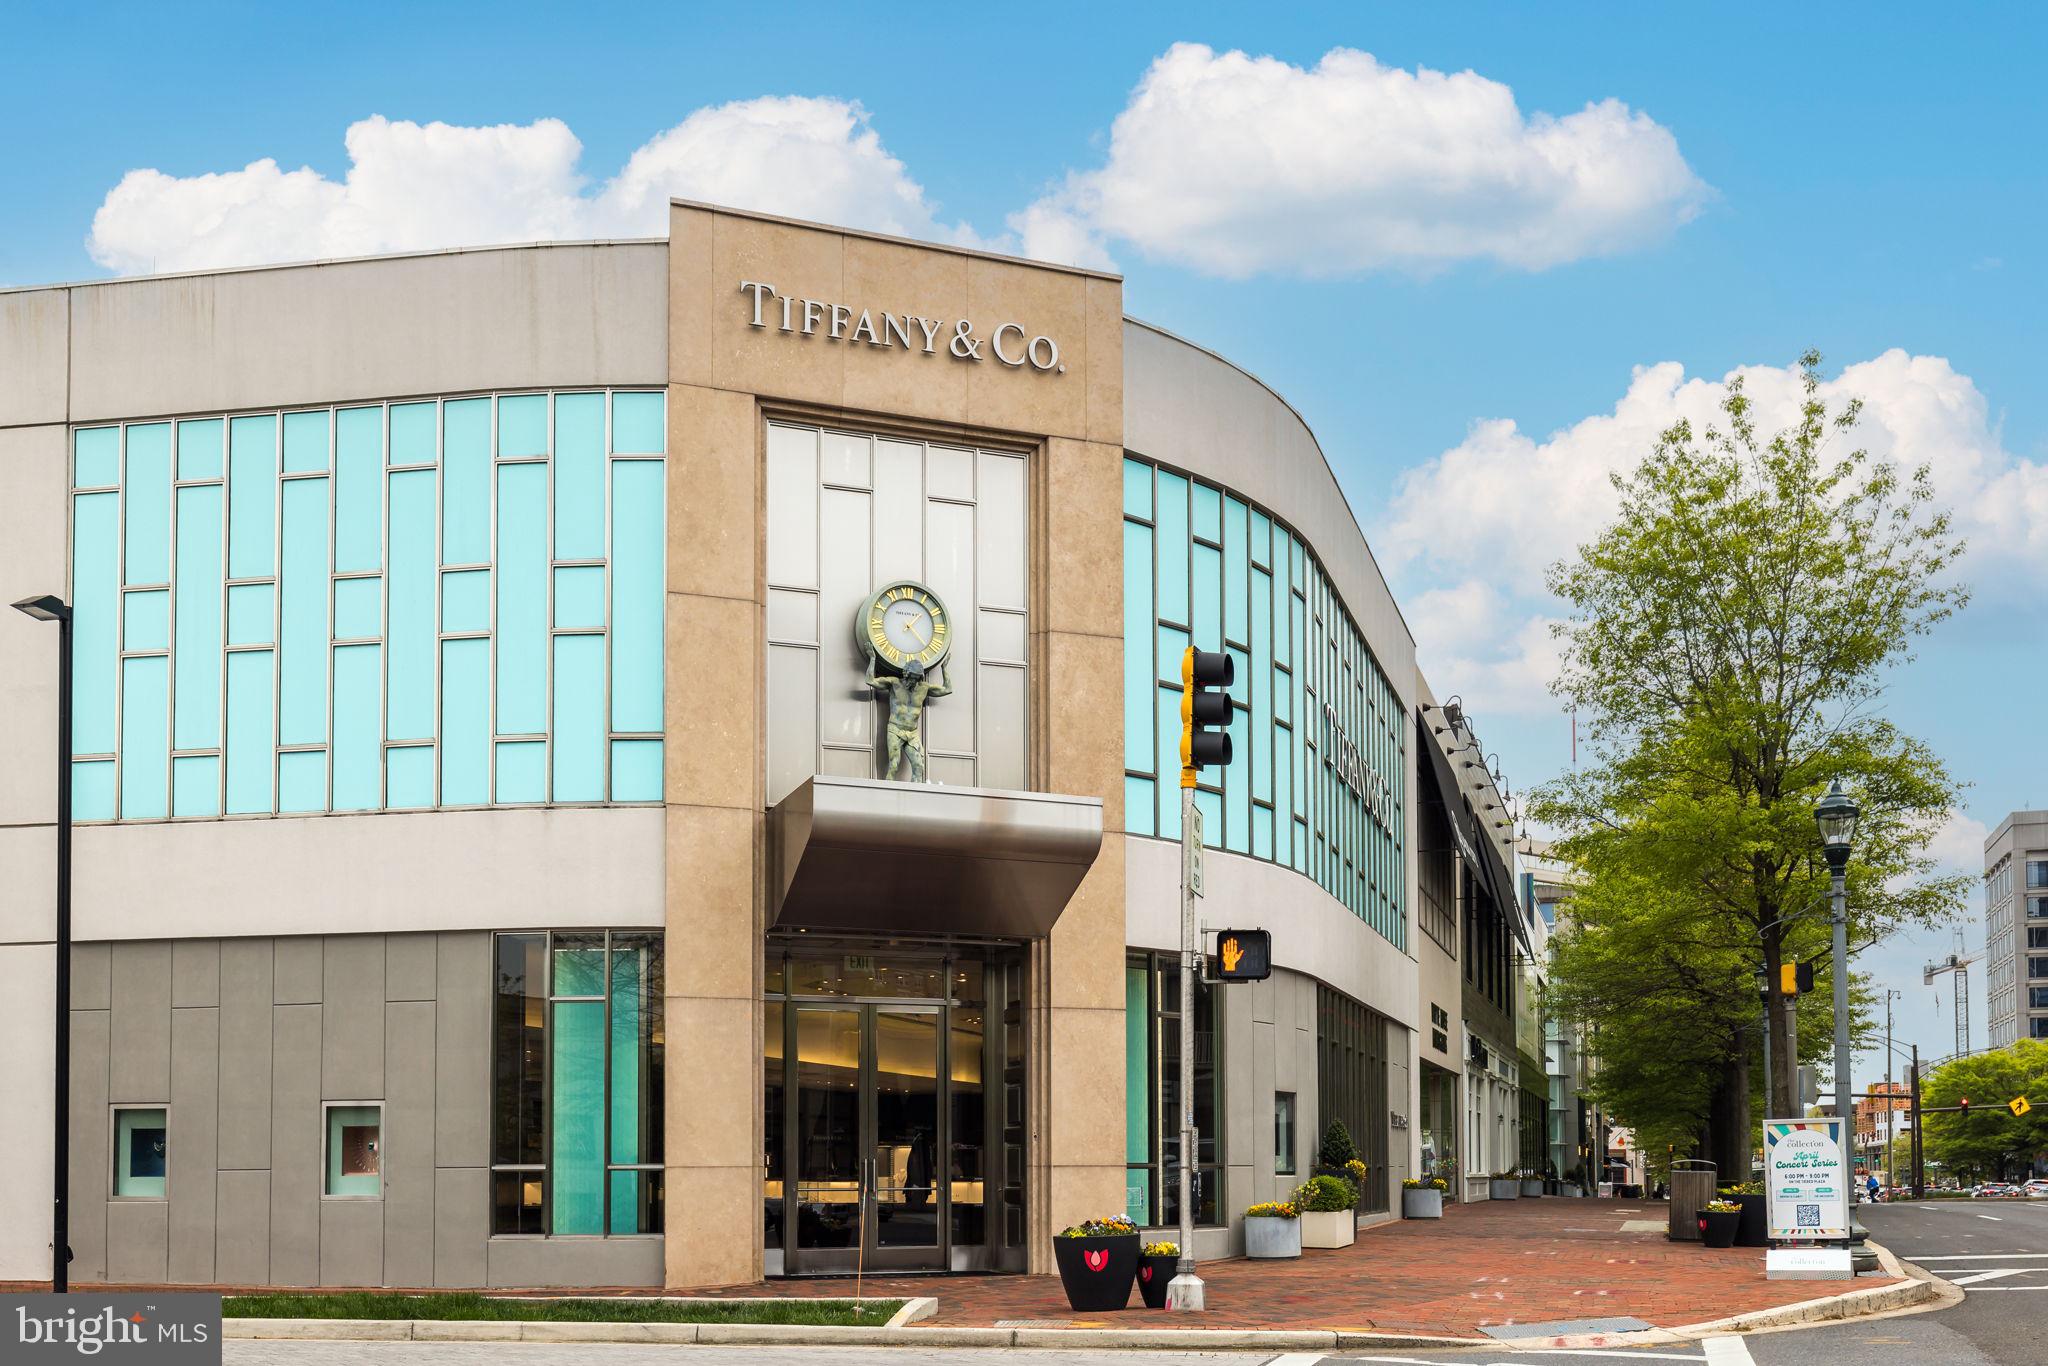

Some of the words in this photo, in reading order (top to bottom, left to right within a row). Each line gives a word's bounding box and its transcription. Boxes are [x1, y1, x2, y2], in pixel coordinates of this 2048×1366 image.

[739, 280, 943, 353] TIFFANY
[949, 319, 984, 360] &
[901, 588, 914, 599] XII
[850, 956, 870, 969] EXIT
[1793, 1151, 1820, 1160] April
[1776, 1161, 1809, 1169] Concert
[1811, 1159, 1838, 1168] Series
